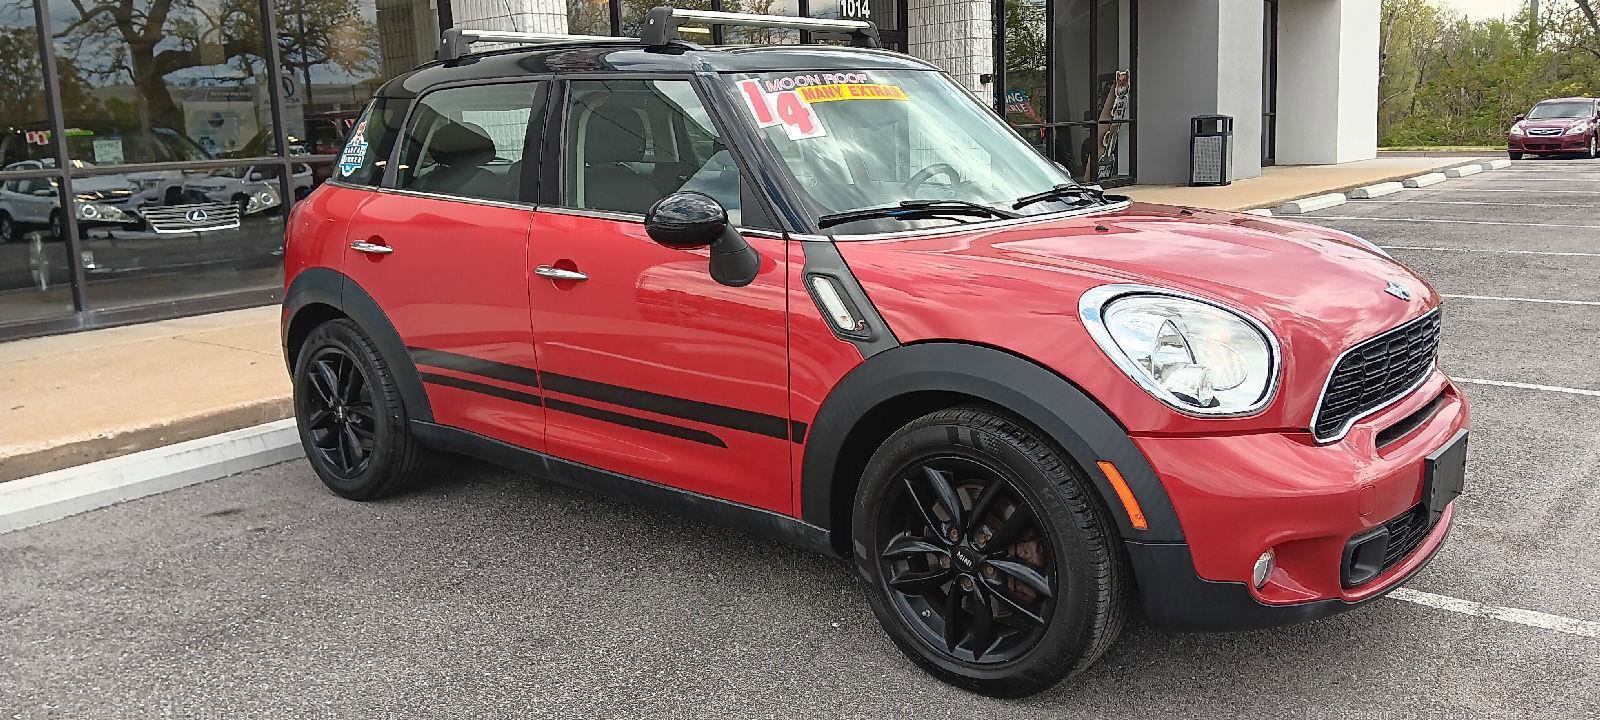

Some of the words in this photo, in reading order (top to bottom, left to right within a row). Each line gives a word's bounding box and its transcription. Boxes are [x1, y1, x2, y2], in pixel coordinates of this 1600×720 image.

[840, 0, 870, 18] 1014
[766, 75, 821, 91] MOON
[822, 73, 867, 84] ROOF
[801, 86, 843, 100] MANY
[847, 85, 903, 97] EXTRAS
[855, 320, 866, 332] S
[957, 550, 973, 567] MINI
